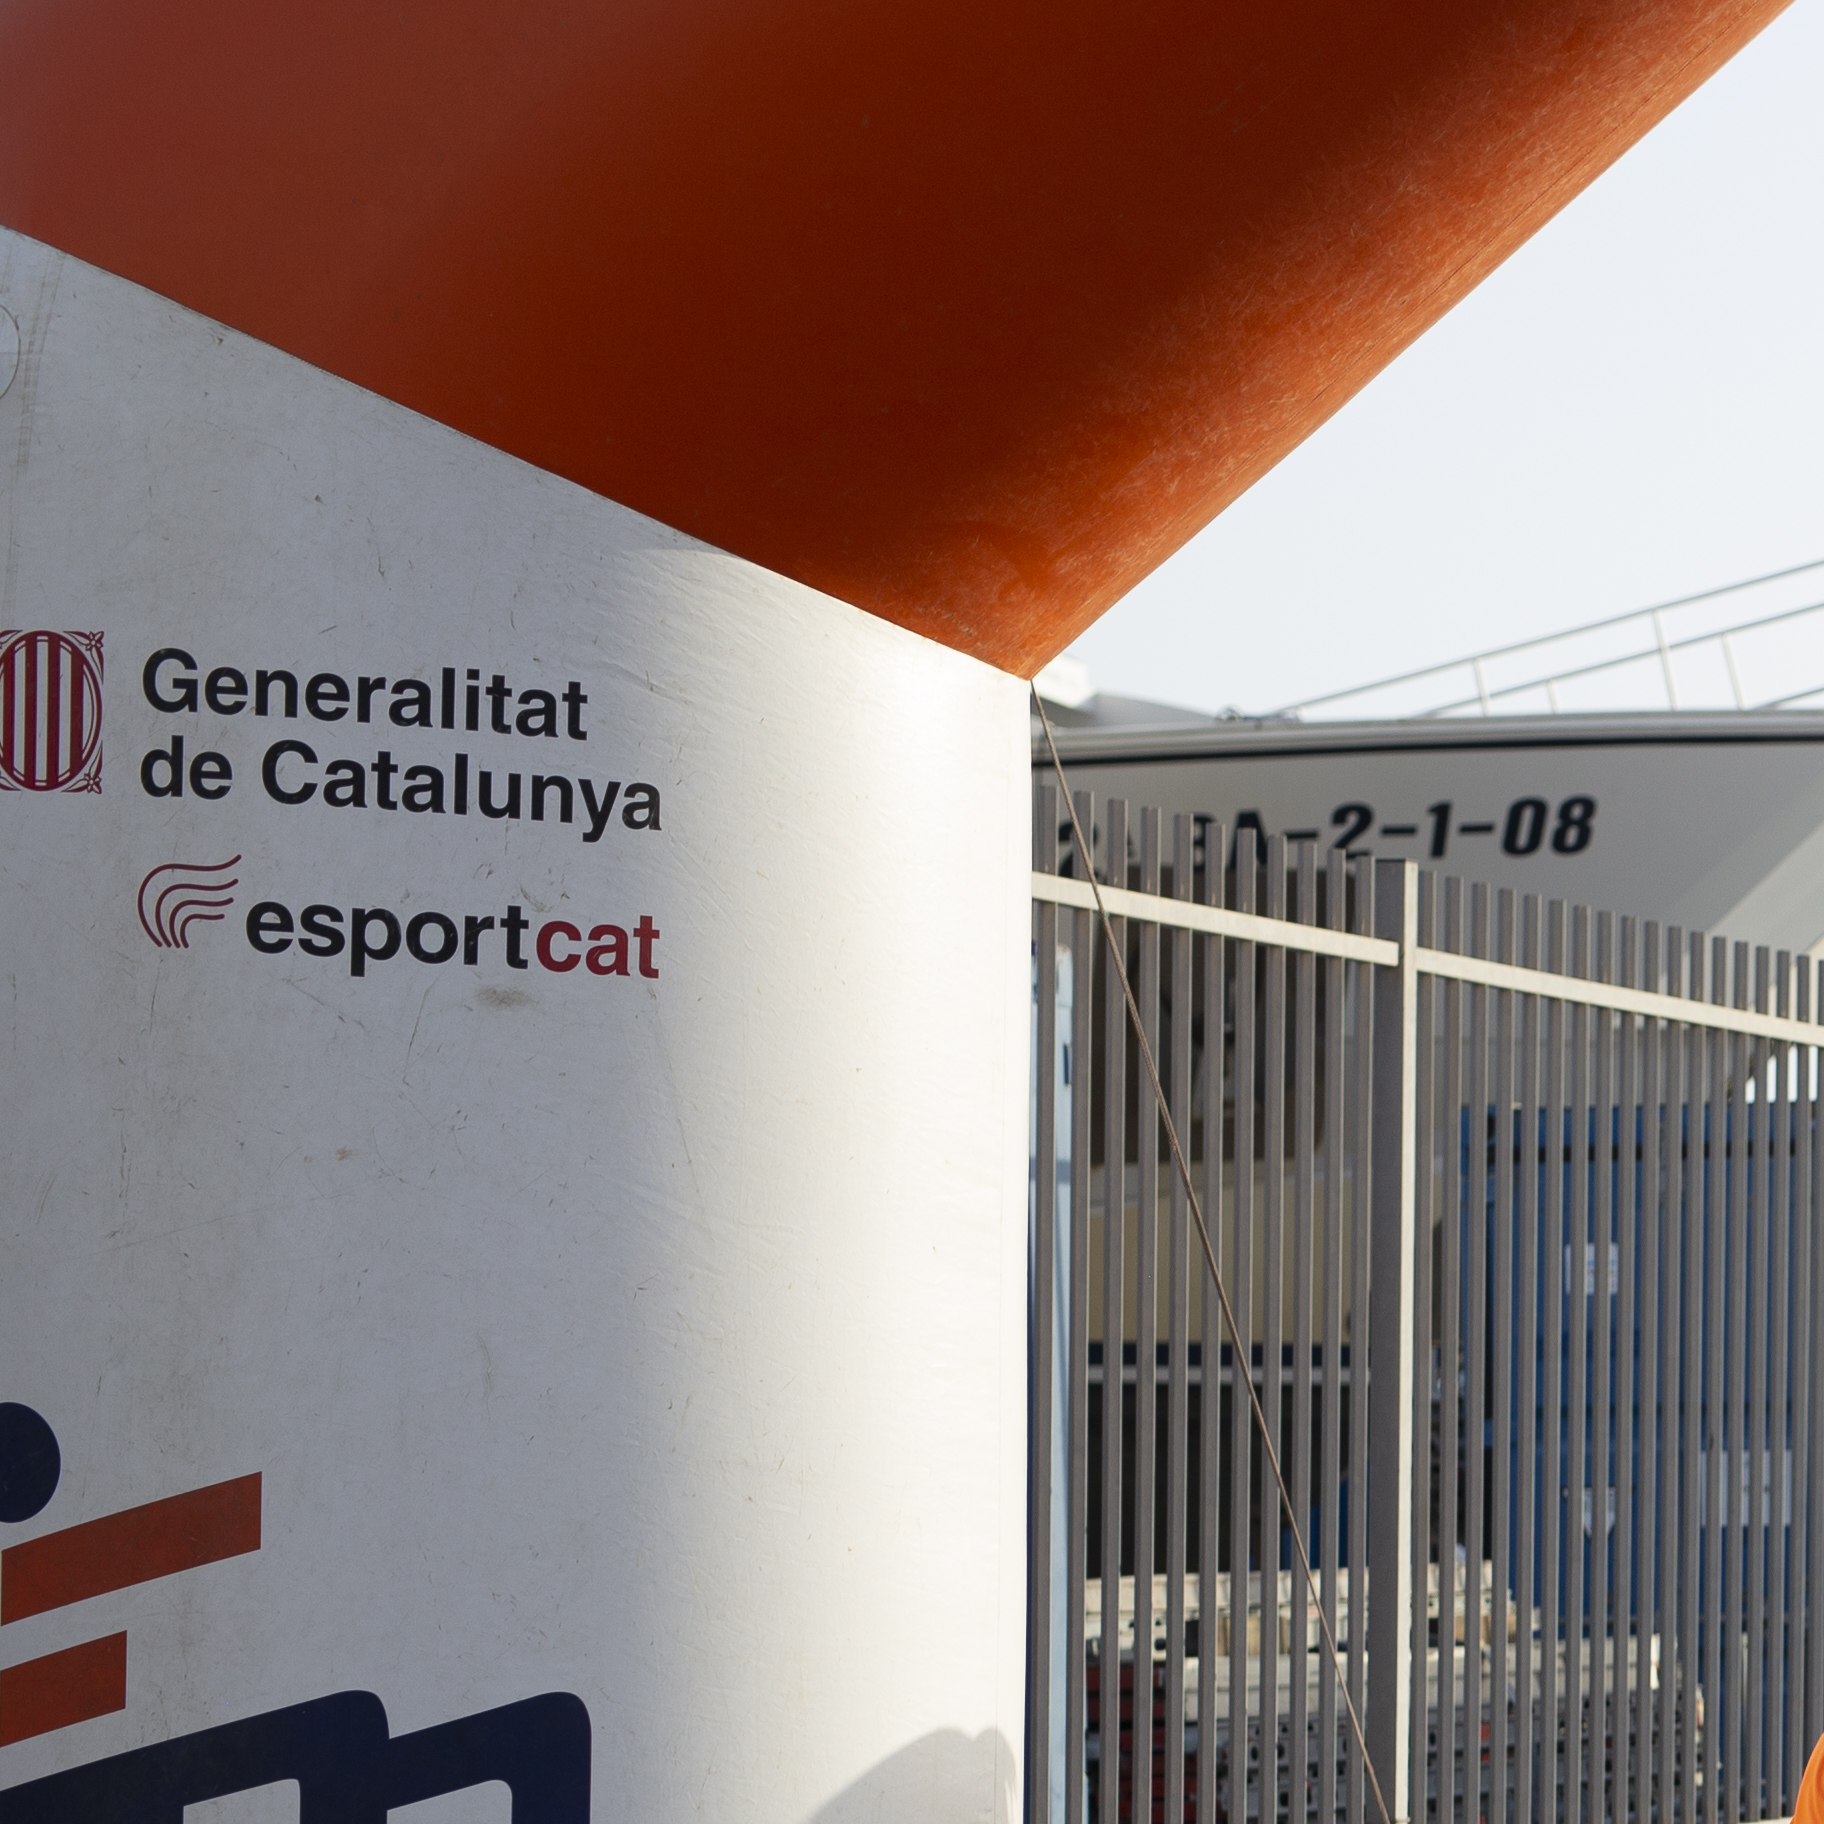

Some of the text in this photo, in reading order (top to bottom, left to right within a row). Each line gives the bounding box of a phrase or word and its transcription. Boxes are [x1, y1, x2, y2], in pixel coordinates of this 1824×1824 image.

[142, 647, 590, 743] Generalitat
[140, 735, 664, 844] de Catalunya
[246, 900, 661, 981] esportcat
